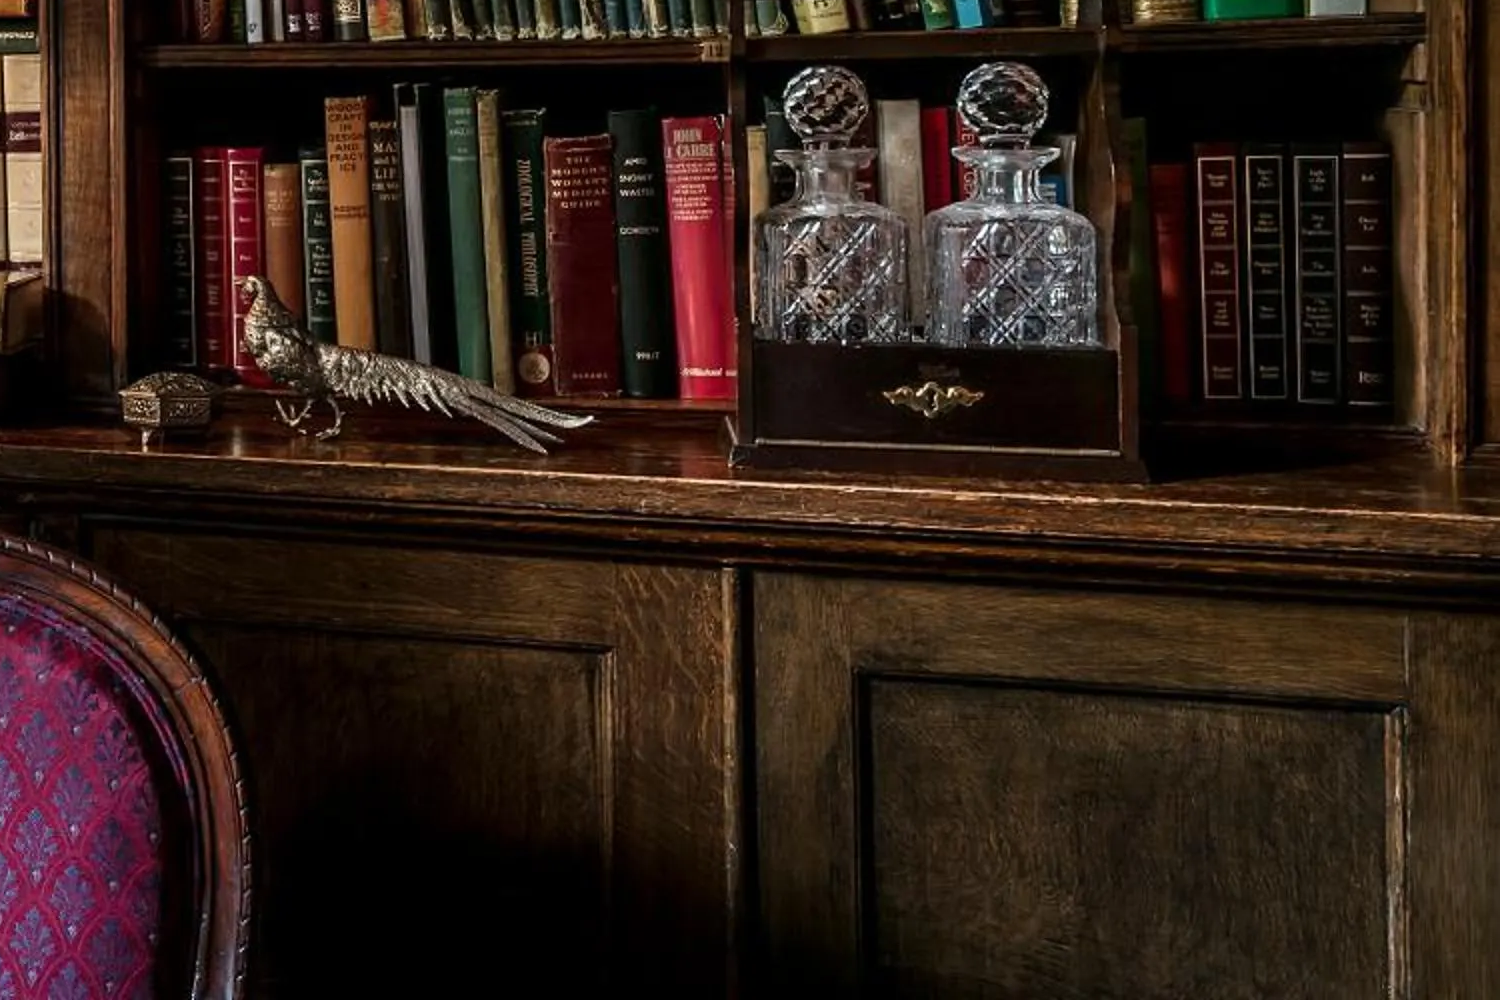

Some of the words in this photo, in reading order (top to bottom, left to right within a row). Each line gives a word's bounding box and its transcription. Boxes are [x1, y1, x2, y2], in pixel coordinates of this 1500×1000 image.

[339, 123, 353, 132] IN
[335, 143, 359, 151] AND
[565, 156, 593, 164] THE
[551, 189, 608, 198] MEDICAL
